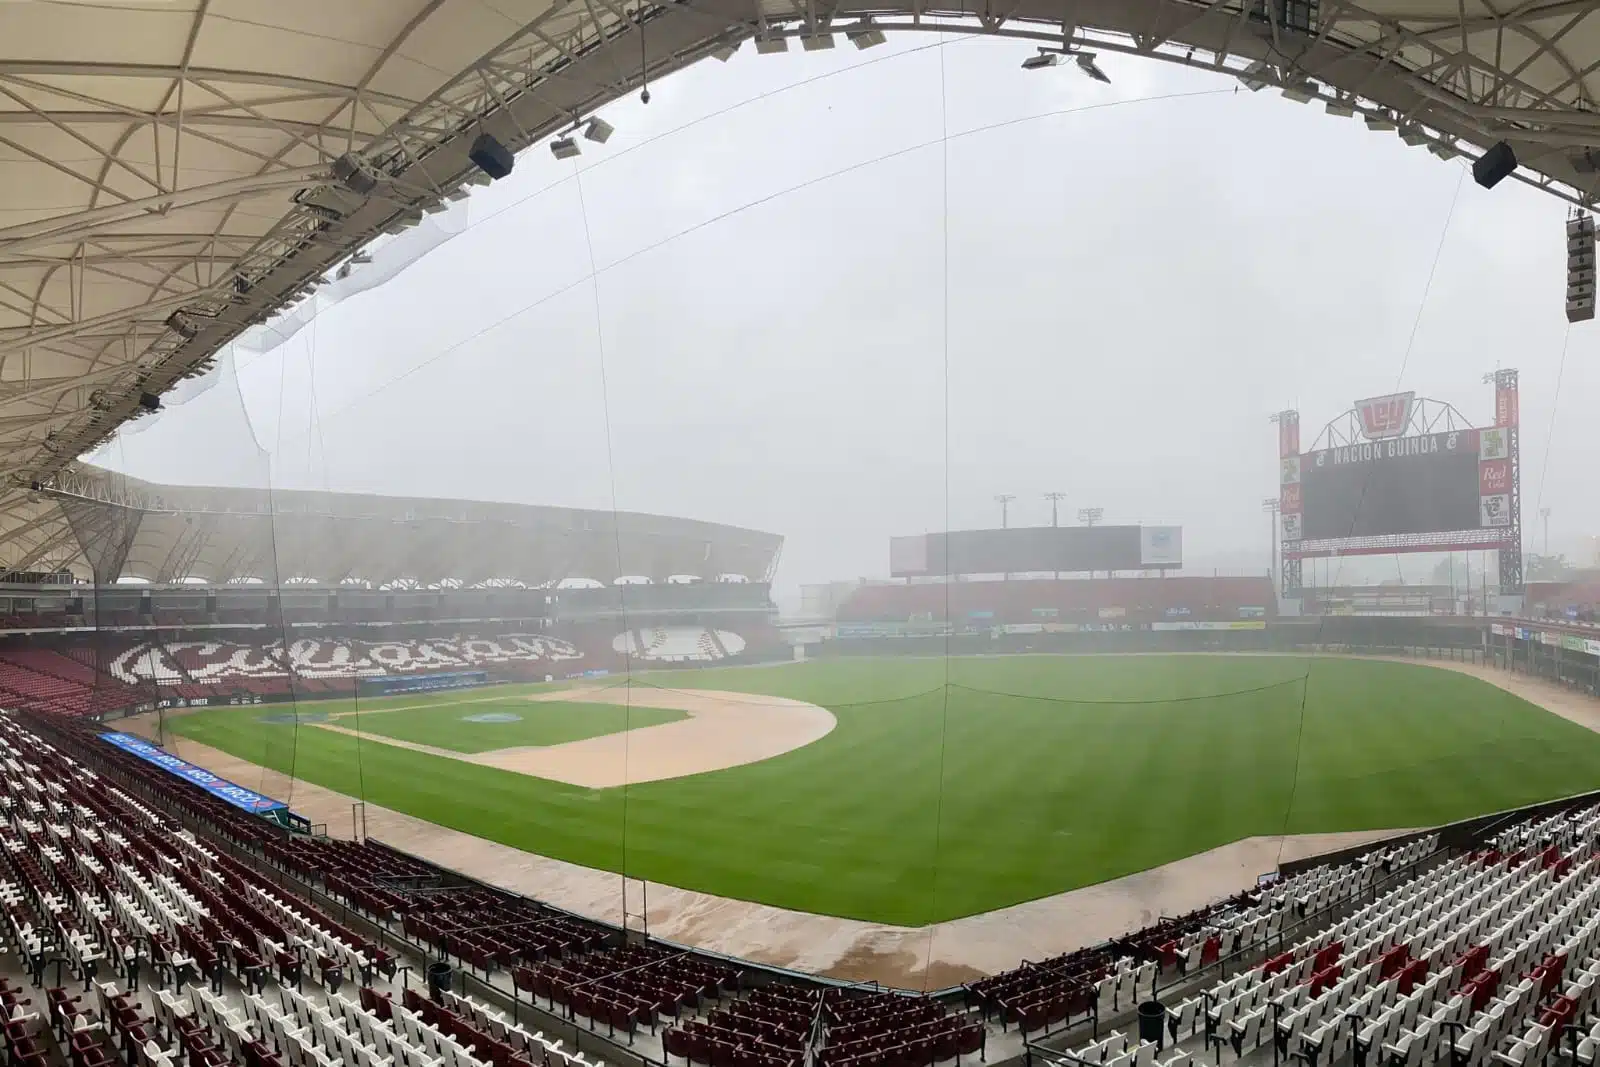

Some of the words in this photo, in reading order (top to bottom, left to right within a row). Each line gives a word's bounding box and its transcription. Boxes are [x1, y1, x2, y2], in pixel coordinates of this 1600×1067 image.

[1388, 435, 1438, 457] GUINDA
[1484, 464, 1507, 480] Red
[187, 769, 218, 783] ARCO
[216, 787, 261, 802] ARCO
